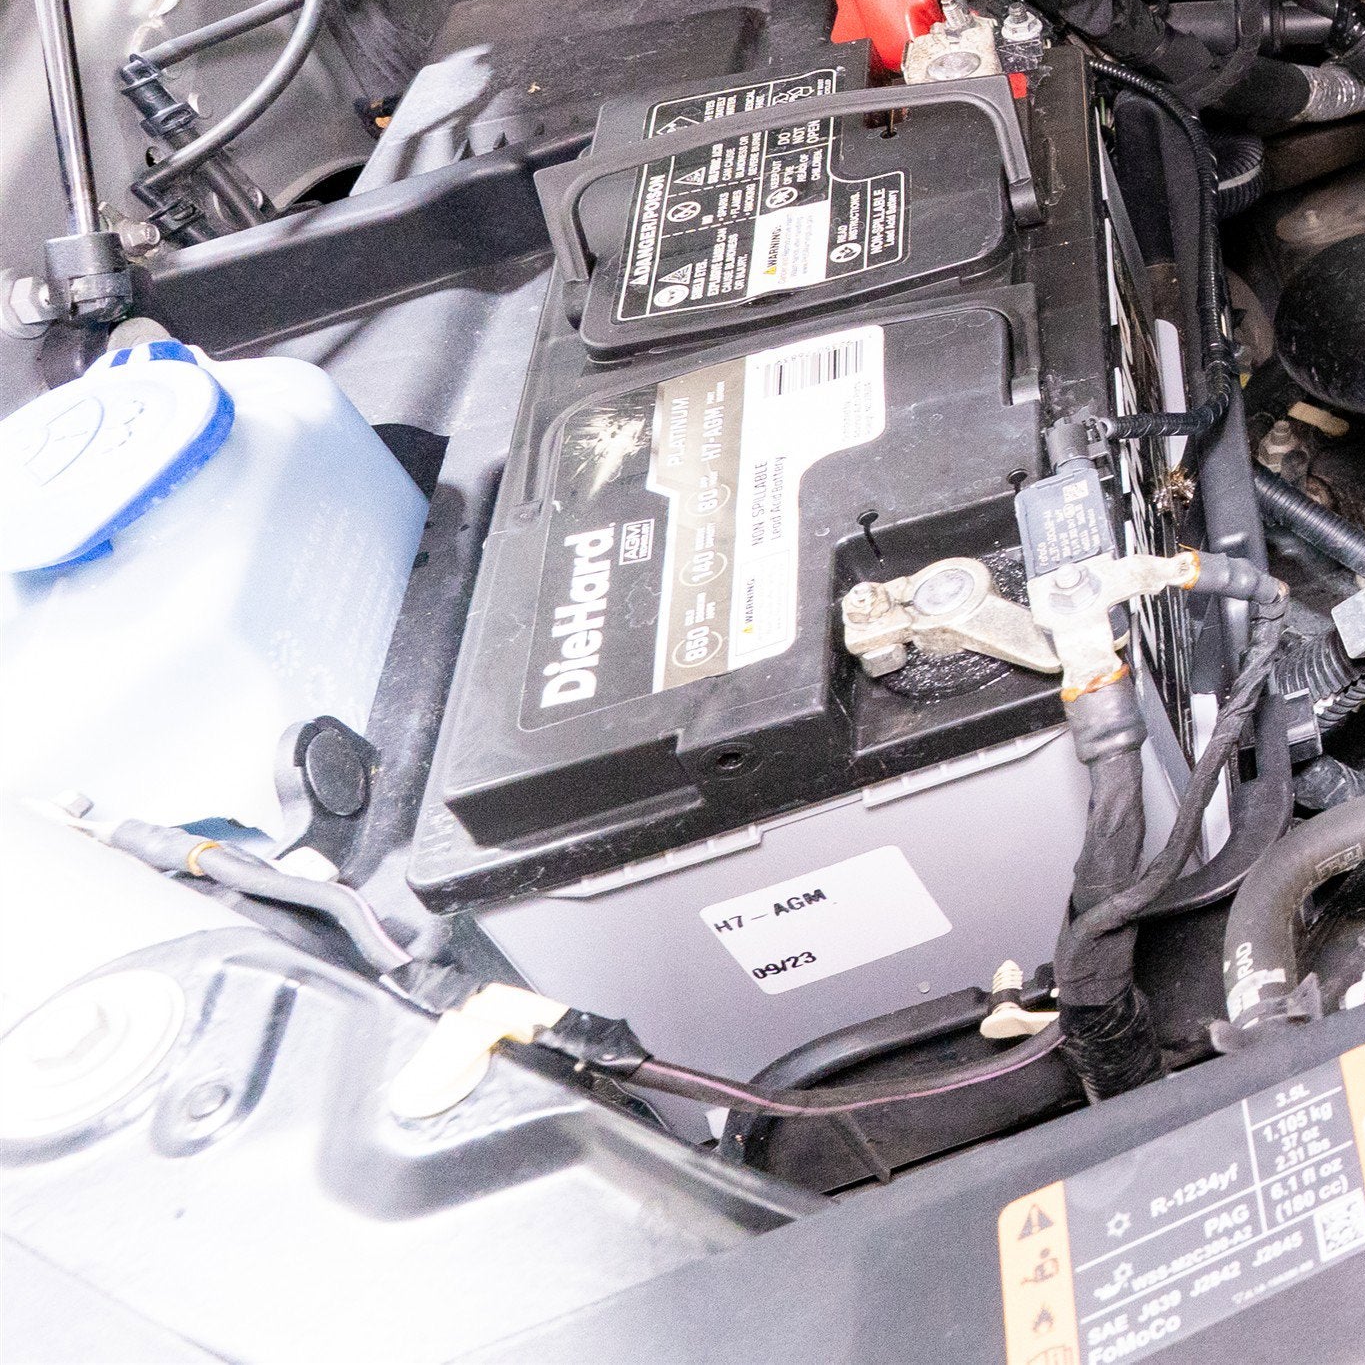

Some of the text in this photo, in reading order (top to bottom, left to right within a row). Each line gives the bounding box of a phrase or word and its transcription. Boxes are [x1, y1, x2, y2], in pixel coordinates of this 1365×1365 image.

[778, 132, 791, 145] DO
[792, 126, 806, 144] NOT
[807, 120, 820, 144] OPEN
[735, 145, 748, 179] BLINDNESS
[633, 174, 666, 276] DANGER/POISON
[716, 227, 727, 243] CAN
[837, 224, 848, 244] READ
[870, 187, 886, 255] NON-SPILLABLE
[884, 190, 899, 247] Lead Acid Battery
[766, 225, 782, 268] WARNING:
[667, 397, 690, 467] PLATINUM
[700, 406, 725, 462] H7-AGM
[751, 461, 768, 546] NON SPILLABLE
[770, 456, 787, 541] Lead Acid Battery
[623, 523, 642, 560] AGM
[691, 550, 715, 582] 140
[744, 578, 755, 624] WARNING
[683, 626, 710, 662] 850
[750, 949, 818, 983] 09/23
[1276, 1083, 1312, 1108] 3.5L
[1262, 1101, 1333, 1143] 1.105 kg
[1279, 1126, 1320, 1151] 37 oz
[1274, 1137, 1332, 1172] 2.31 lbs
[1149, 1161, 1239, 1217] R-1234yf
[1269, 1159, 1344, 1202] 6.1 fl oz
[1274, 1172, 1350, 1225] (180 cc)
[1204, 1203, 1249, 1240] PAG
[1087, 1313, 1129, 1345] SAE
[1088, 1314, 1182, 1365] FoMoCo
